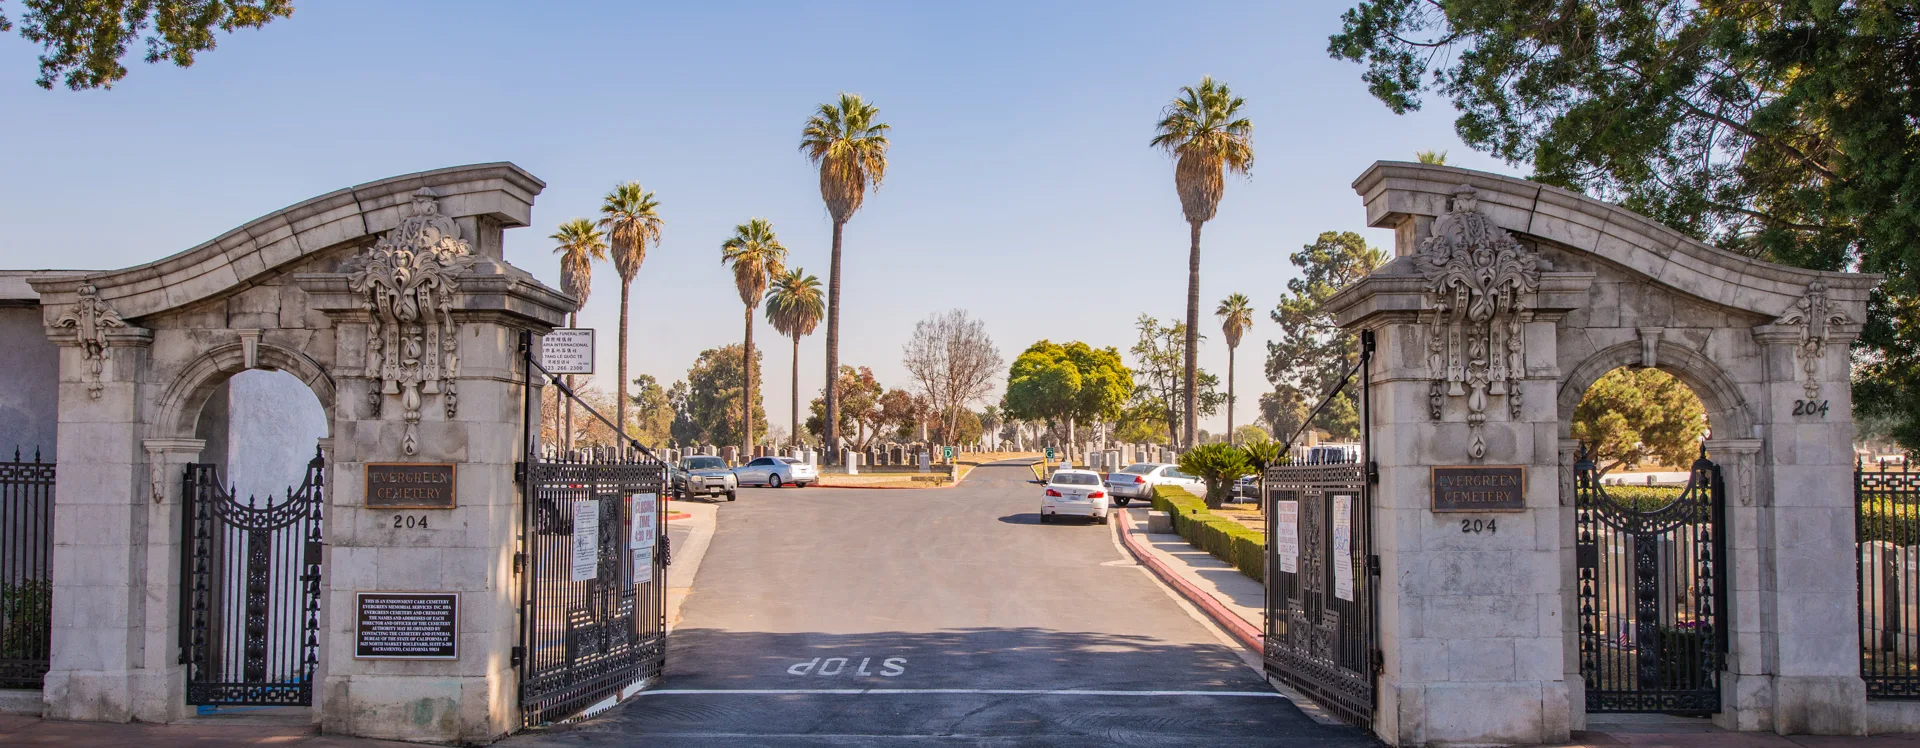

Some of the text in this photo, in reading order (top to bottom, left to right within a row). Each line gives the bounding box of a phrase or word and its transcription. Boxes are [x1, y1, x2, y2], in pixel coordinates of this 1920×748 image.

[1792, 400, 1828, 418] 204
[373, 472, 448, 483] EVERGREEN
[1440, 475, 1517, 487] EVERGREEN
[377, 487, 442, 499] CEMETERY
[1444, 491, 1512, 502] CEMETERY
[636, 500, 654, 513] CLOSING
[394, 515, 428, 528] 204
[639, 515, 650, 528] TIME
[1462, 518, 1497, 534] 204
[635, 530, 644, 542] 4:30
[787, 657, 908, 676] STOP
